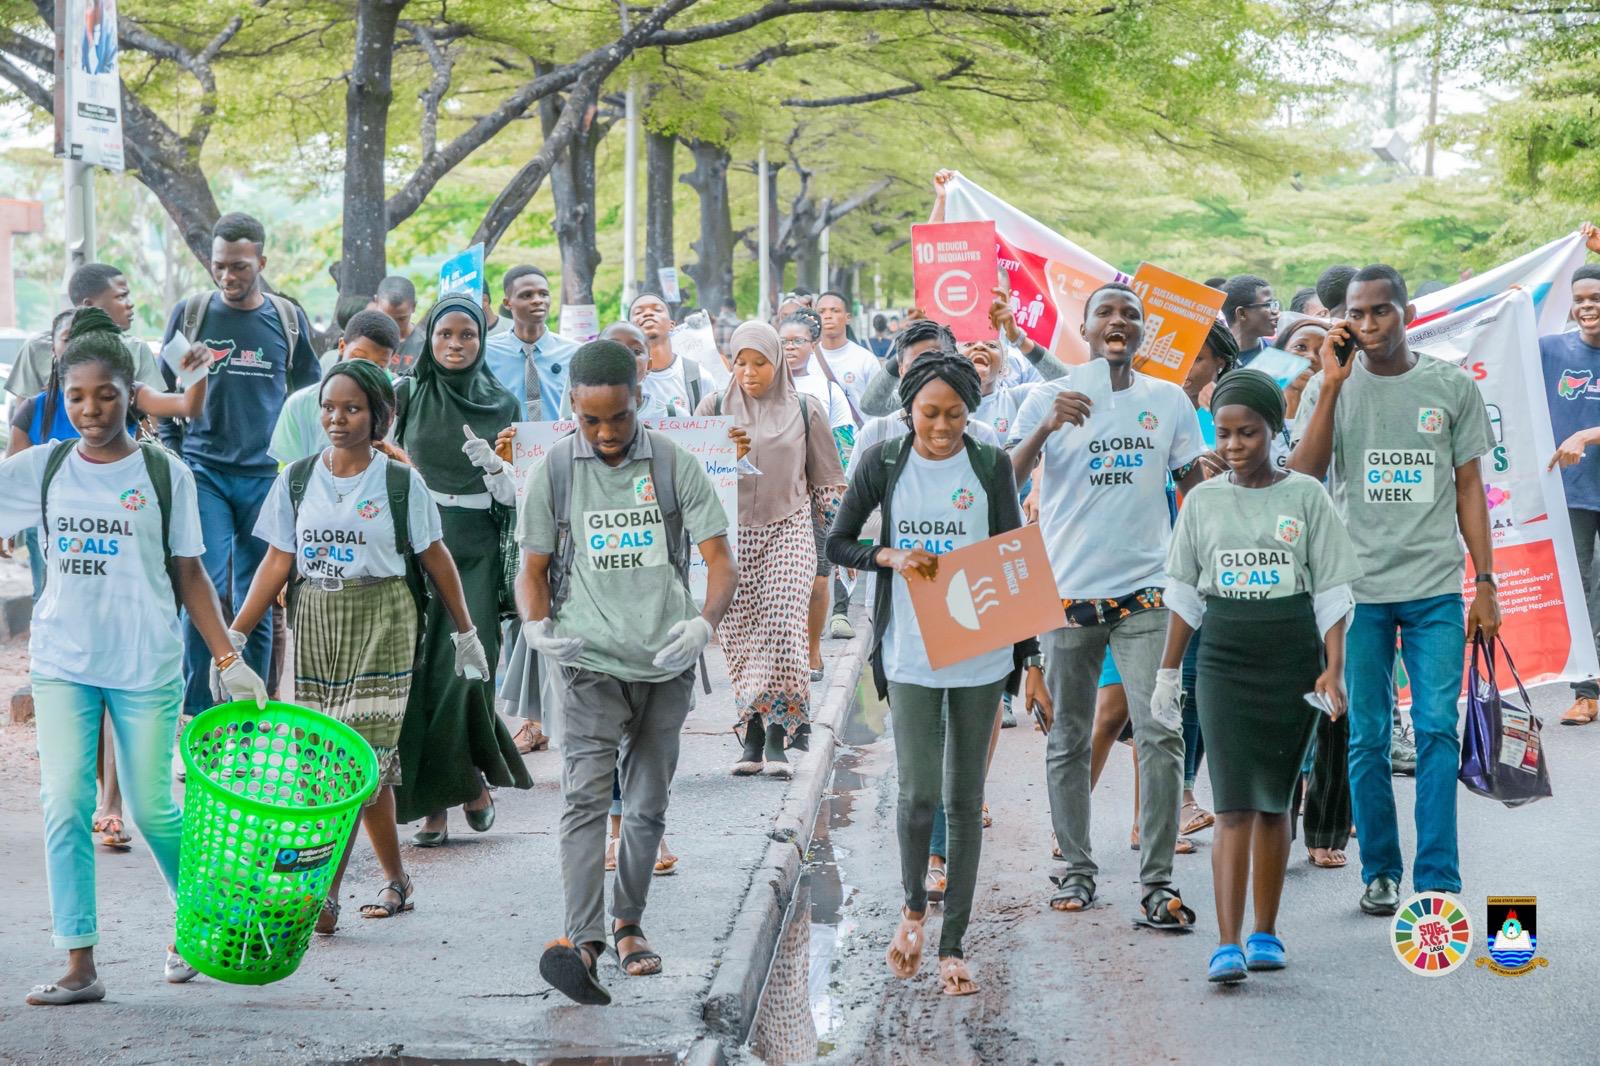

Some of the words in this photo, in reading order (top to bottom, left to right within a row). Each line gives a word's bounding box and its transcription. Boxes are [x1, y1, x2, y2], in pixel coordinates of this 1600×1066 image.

[917, 242, 934, 264] 10
[937, 240, 968, 251] REDUCED
[938, 250, 981, 263] INEQUALITIES
[996, 258, 1020, 272] VERTY
[1056, 273, 1068, 295] 2
[658, 420, 726, 431] EQUALITY
[1089, 436, 1154, 454] GLOBAL
[1089, 453, 1144, 470] GOALS
[1368, 452, 1434, 465] GLOBAL
[1090, 471, 1134, 486] WEEK
[1368, 469, 1422, 484] GOALS
[1368, 488, 1413, 501] WEEK
[58, 517, 133, 536] GLOBAL
[589, 509, 662, 530] GLOBAL
[899, 520, 966, 536] GLOBAL
[303, 529, 366, 545] GLOBAL
[590, 530, 654, 550] GOALS
[58, 536, 119, 556] GOALS
[303, 545, 354, 562] GOALS
[998, 539, 1021, 555] 2
[60, 558, 107, 576] WEEK
[592, 552, 644, 570] WEEK
[1220, 552, 1290, 567] GLOBAL
[306, 560, 345, 578] WEEK
[1221, 569, 1280, 586] GOALS
[1510, 573, 1554, 587] excessively?
[1496, 586, 1528, 598] rotected
[1511, 594, 1542, 606] partner?
